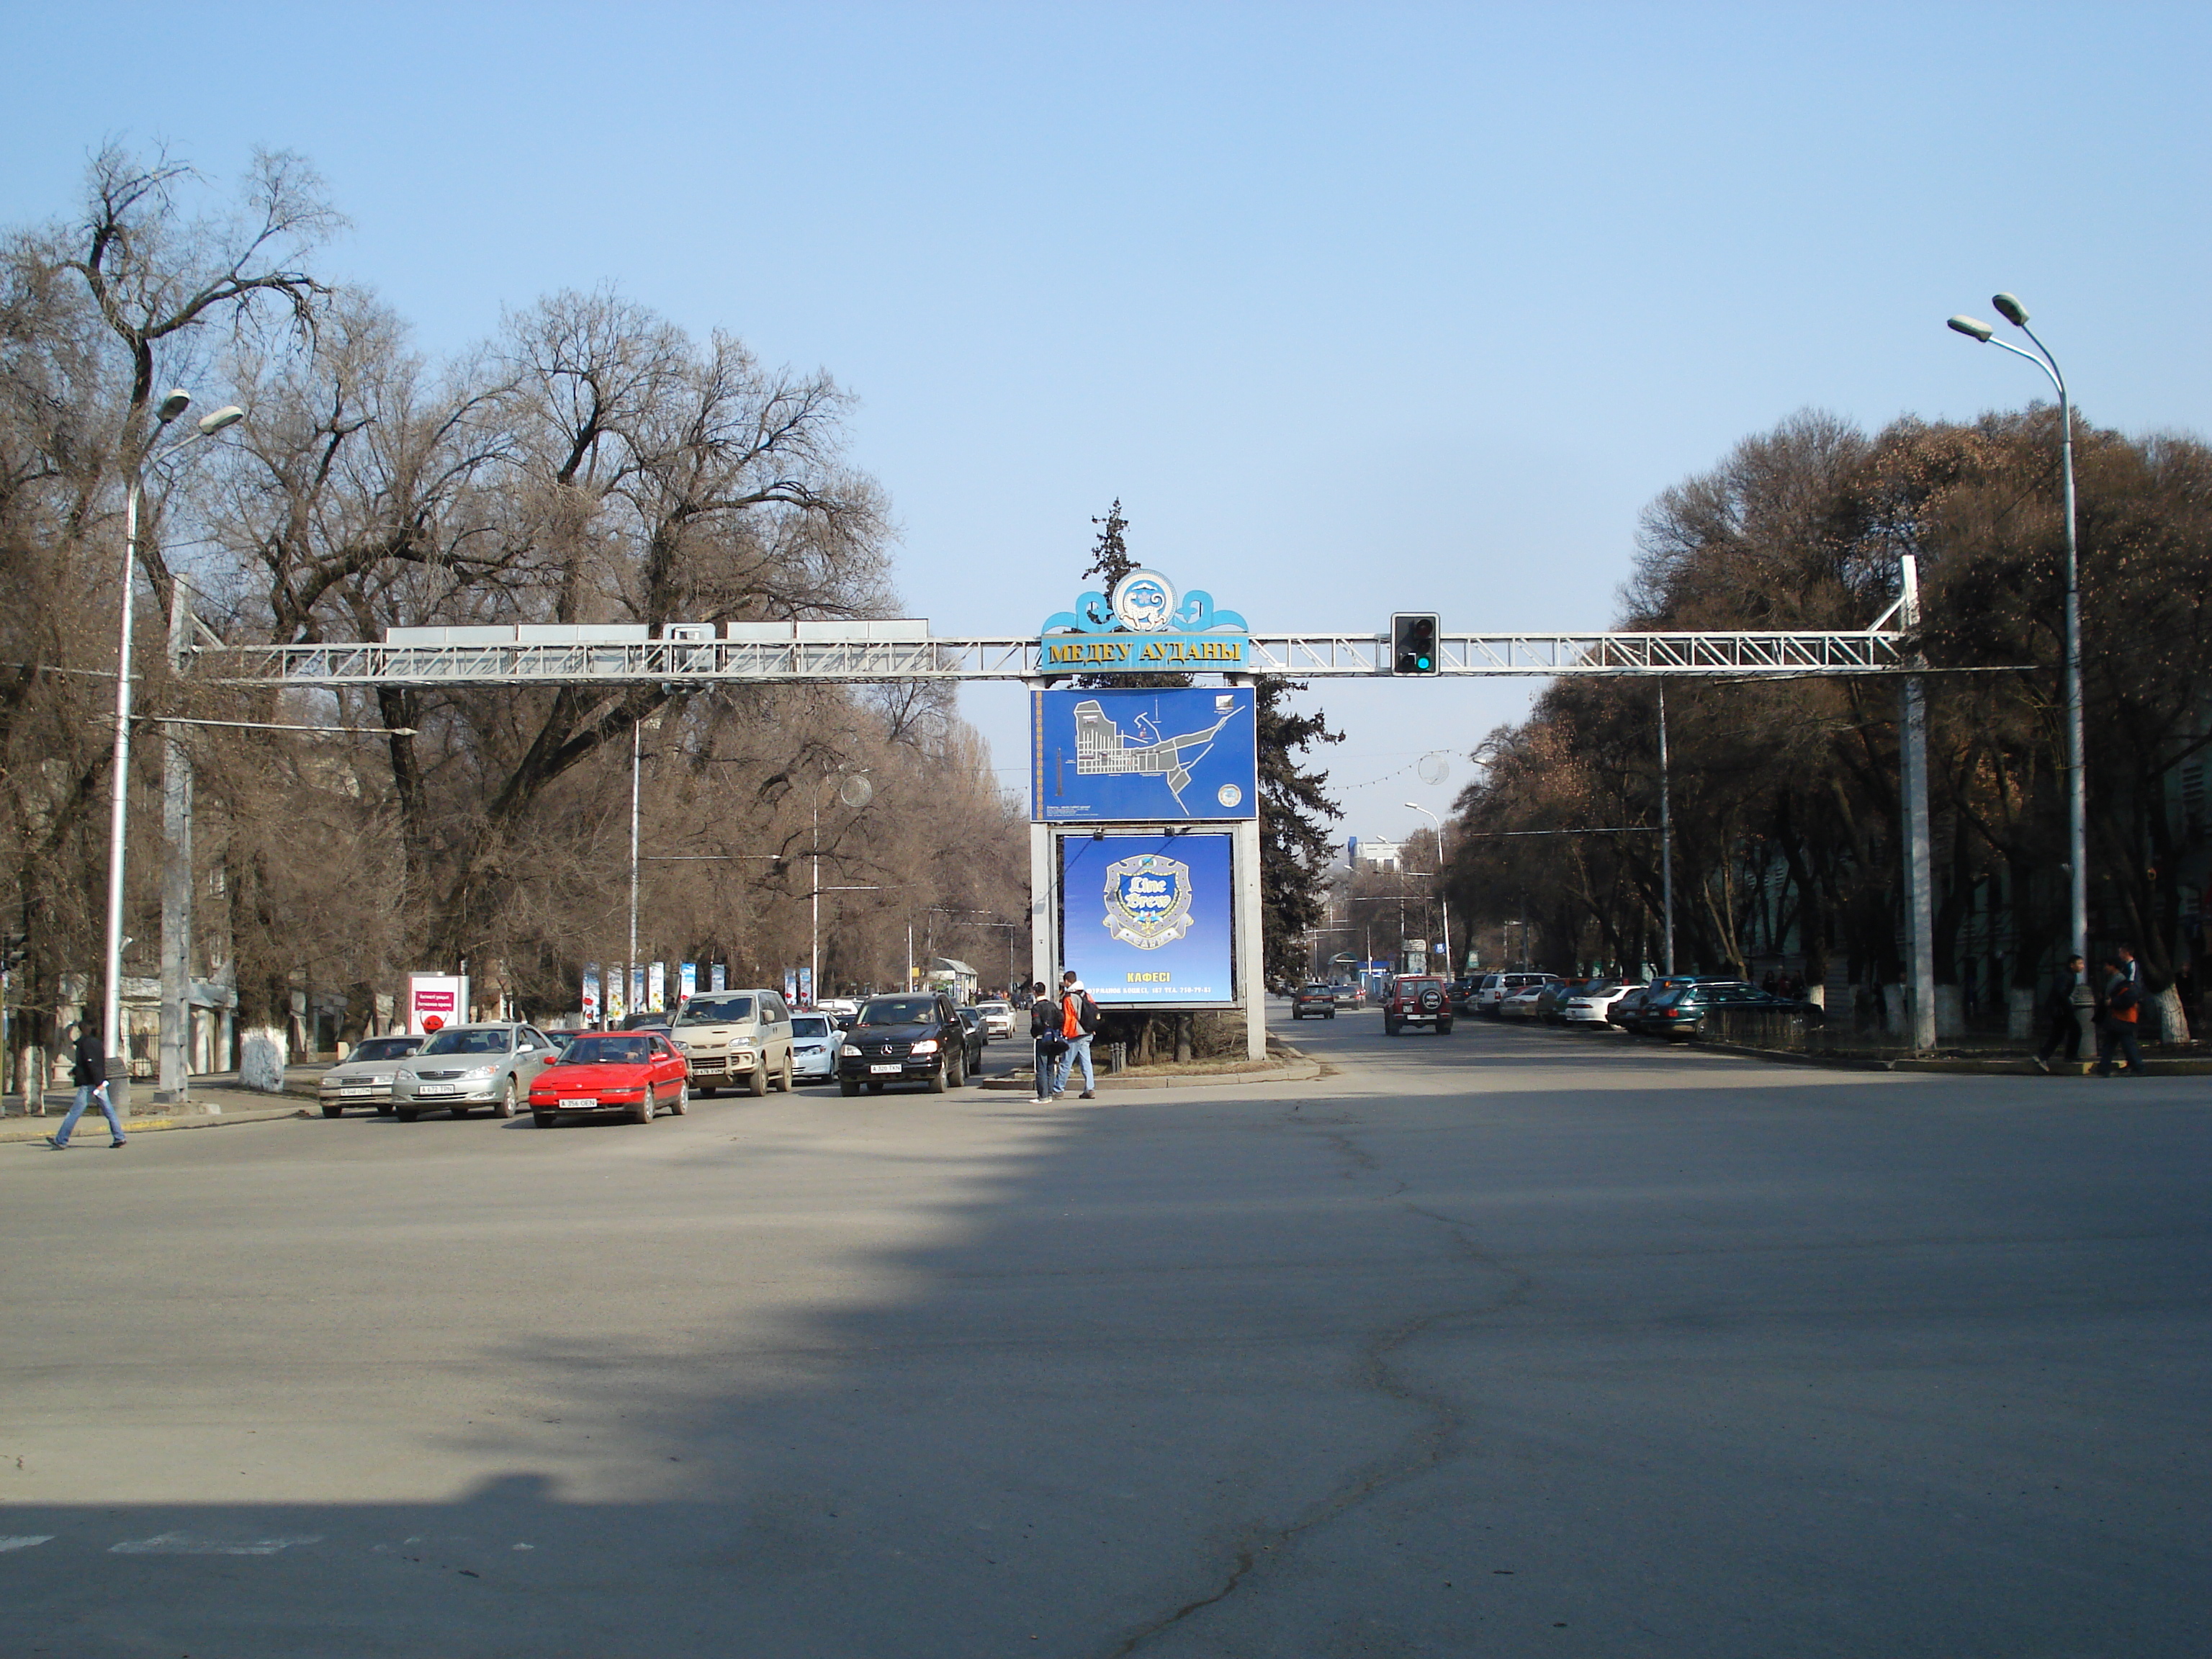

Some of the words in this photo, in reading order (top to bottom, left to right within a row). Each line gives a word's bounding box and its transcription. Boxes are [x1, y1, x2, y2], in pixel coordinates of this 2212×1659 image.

[1048, 643, 1134, 665] МЕДЕУ
[1139, 643, 1241, 664] АУДАНЫ
[1128, 876, 1167, 894] Line
[1125, 892, 1172, 909] Brew
